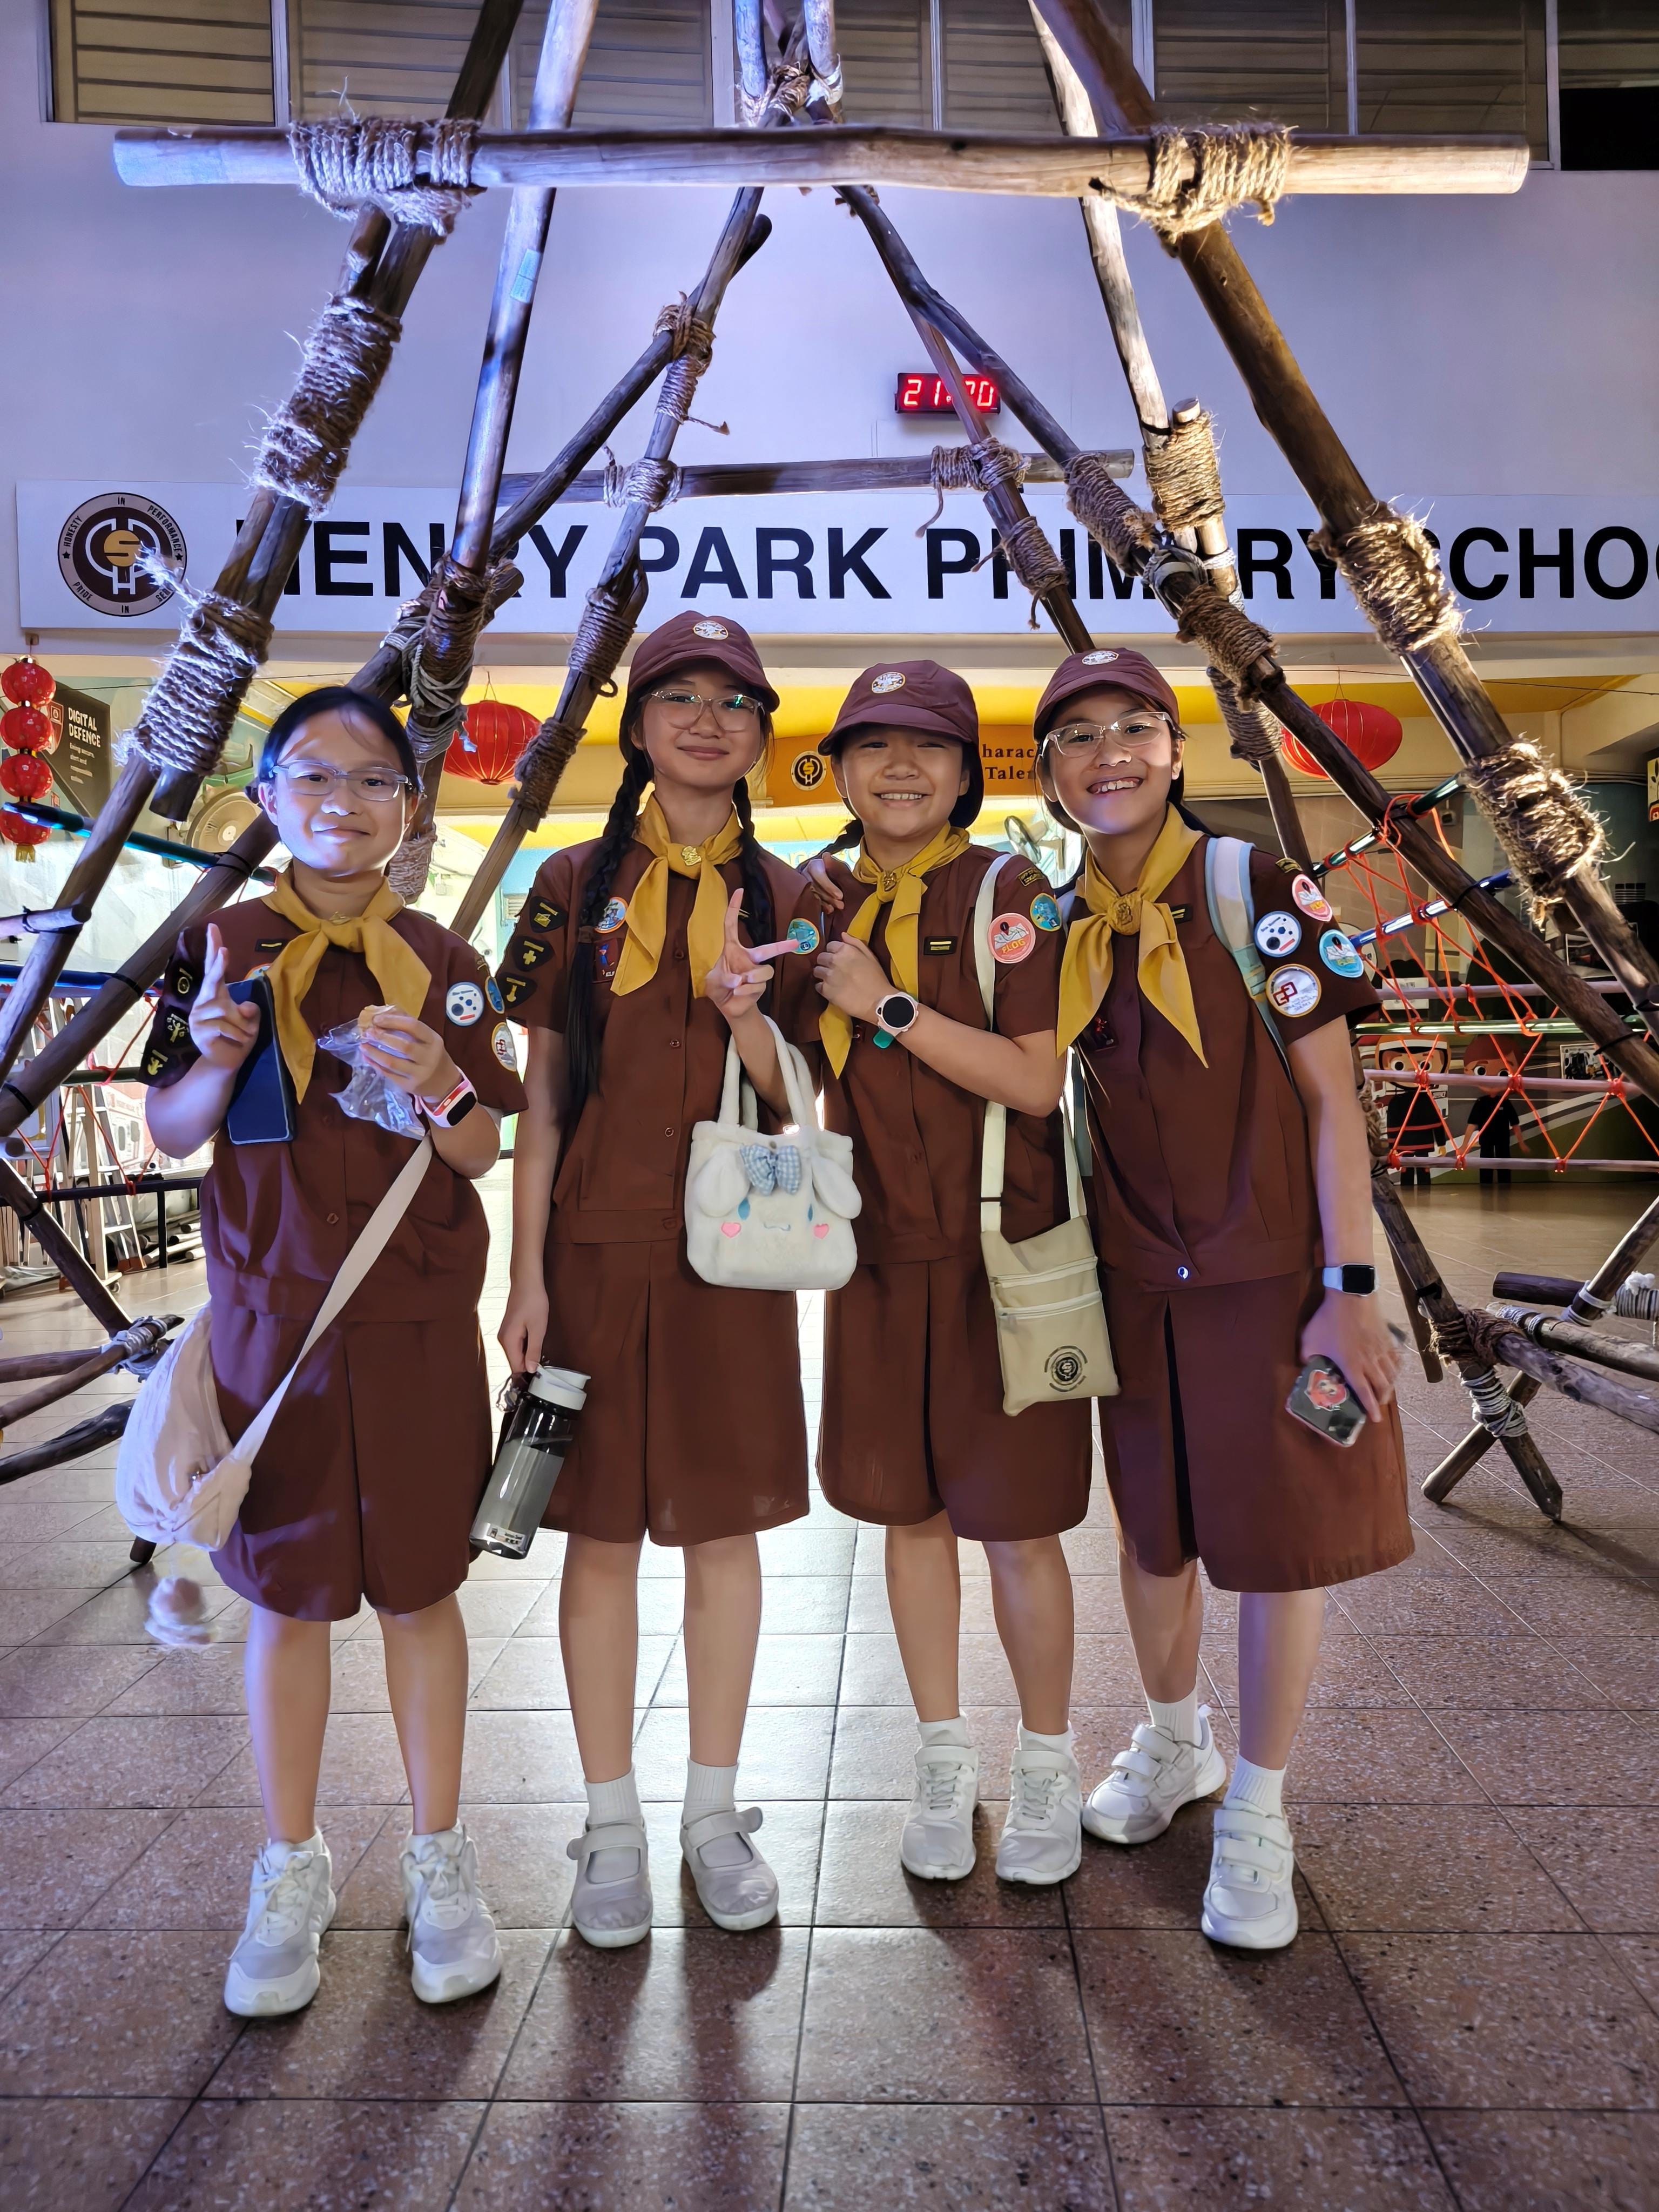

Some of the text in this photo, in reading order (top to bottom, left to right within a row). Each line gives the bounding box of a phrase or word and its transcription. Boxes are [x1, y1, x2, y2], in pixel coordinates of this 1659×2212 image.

[64, 496, 183, 552] HONESTY IN PERFORMANCE
[72, 581, 129, 613] PRIDE IN
[68, 707, 97, 731] DIGITAL
[69, 723, 101, 748] DEFENCE
[984, 765, 1031, 780] Tale
